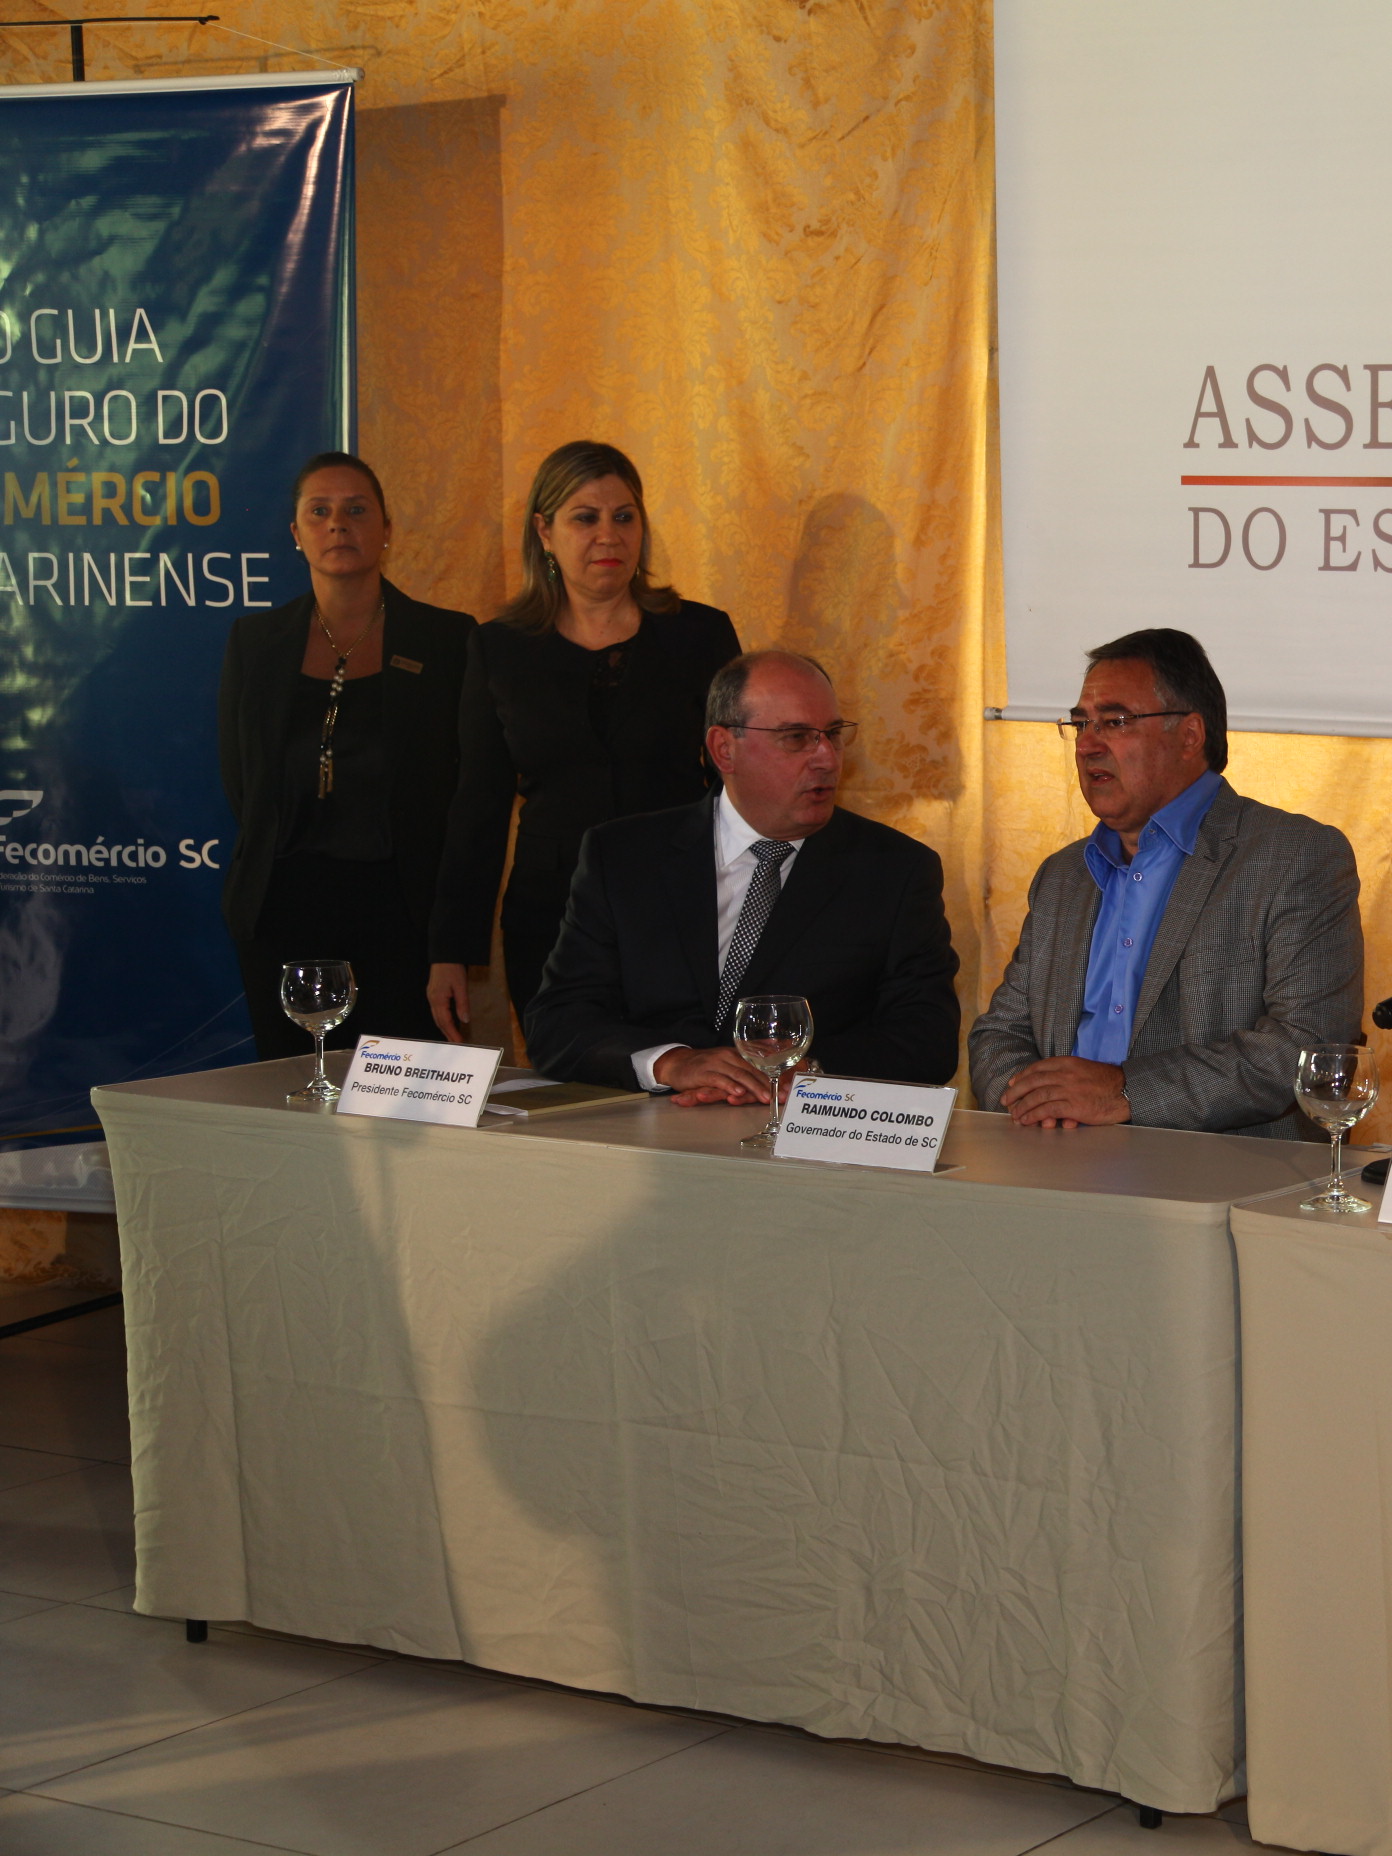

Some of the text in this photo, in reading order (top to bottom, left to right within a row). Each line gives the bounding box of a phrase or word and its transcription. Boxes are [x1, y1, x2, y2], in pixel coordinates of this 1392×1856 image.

[30, 308, 164, 365] GUIA
[157, 388, 228, 445] DO
[3, 457, 221, 527] MÉRCIO
[1188, 506, 1288, 571] DO
[178, 838, 220, 869] SC
[361, 1050, 413, 1062] Fecomércio SC
[364, 1062, 474, 1085] BRUNO BREITHAUPT
[351, 1081, 473, 1105] Presidente Fecomércio SC
[796, 1089, 856, 1102] Fecomércio SC
[801, 1103, 934, 1127] RAIMUNDO COLOMBO
[786, 1122, 938, 1149] Governador do Estado de SC
